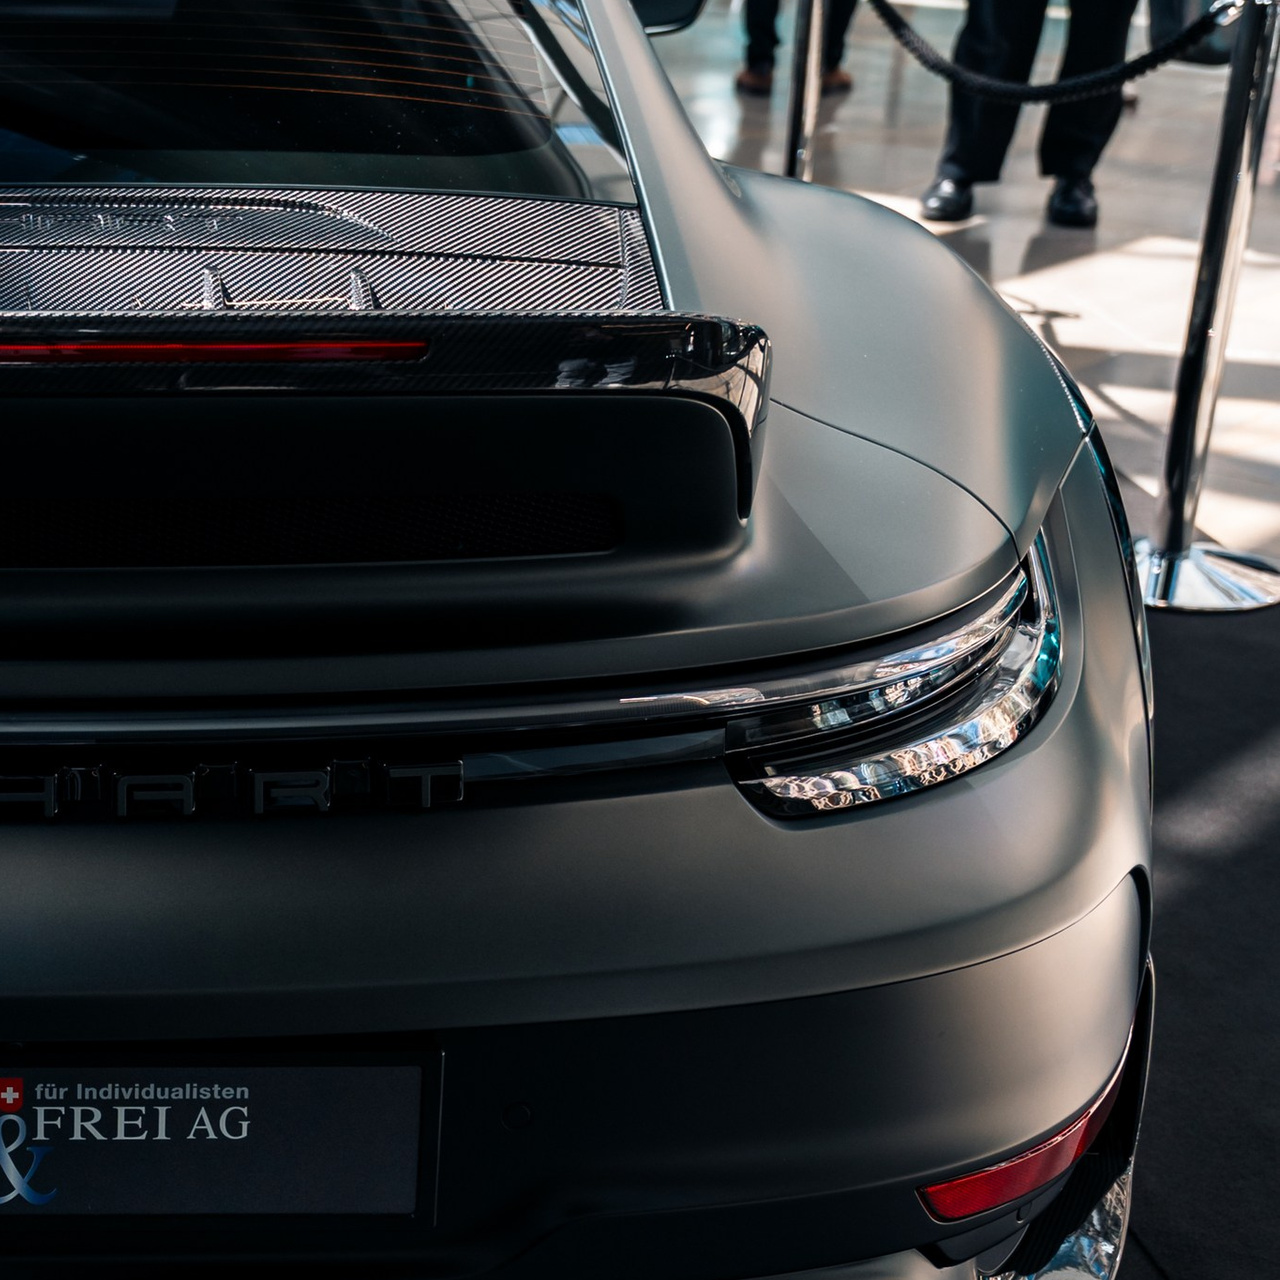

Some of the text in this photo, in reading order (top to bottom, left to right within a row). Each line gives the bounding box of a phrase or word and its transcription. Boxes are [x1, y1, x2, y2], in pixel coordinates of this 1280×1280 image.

[34, 1082, 69, 1101] für
[77, 1082, 250, 1101] Individualisten
[31, 1105, 172, 1142] FREI
[186, 1106, 251, 1141] AG
